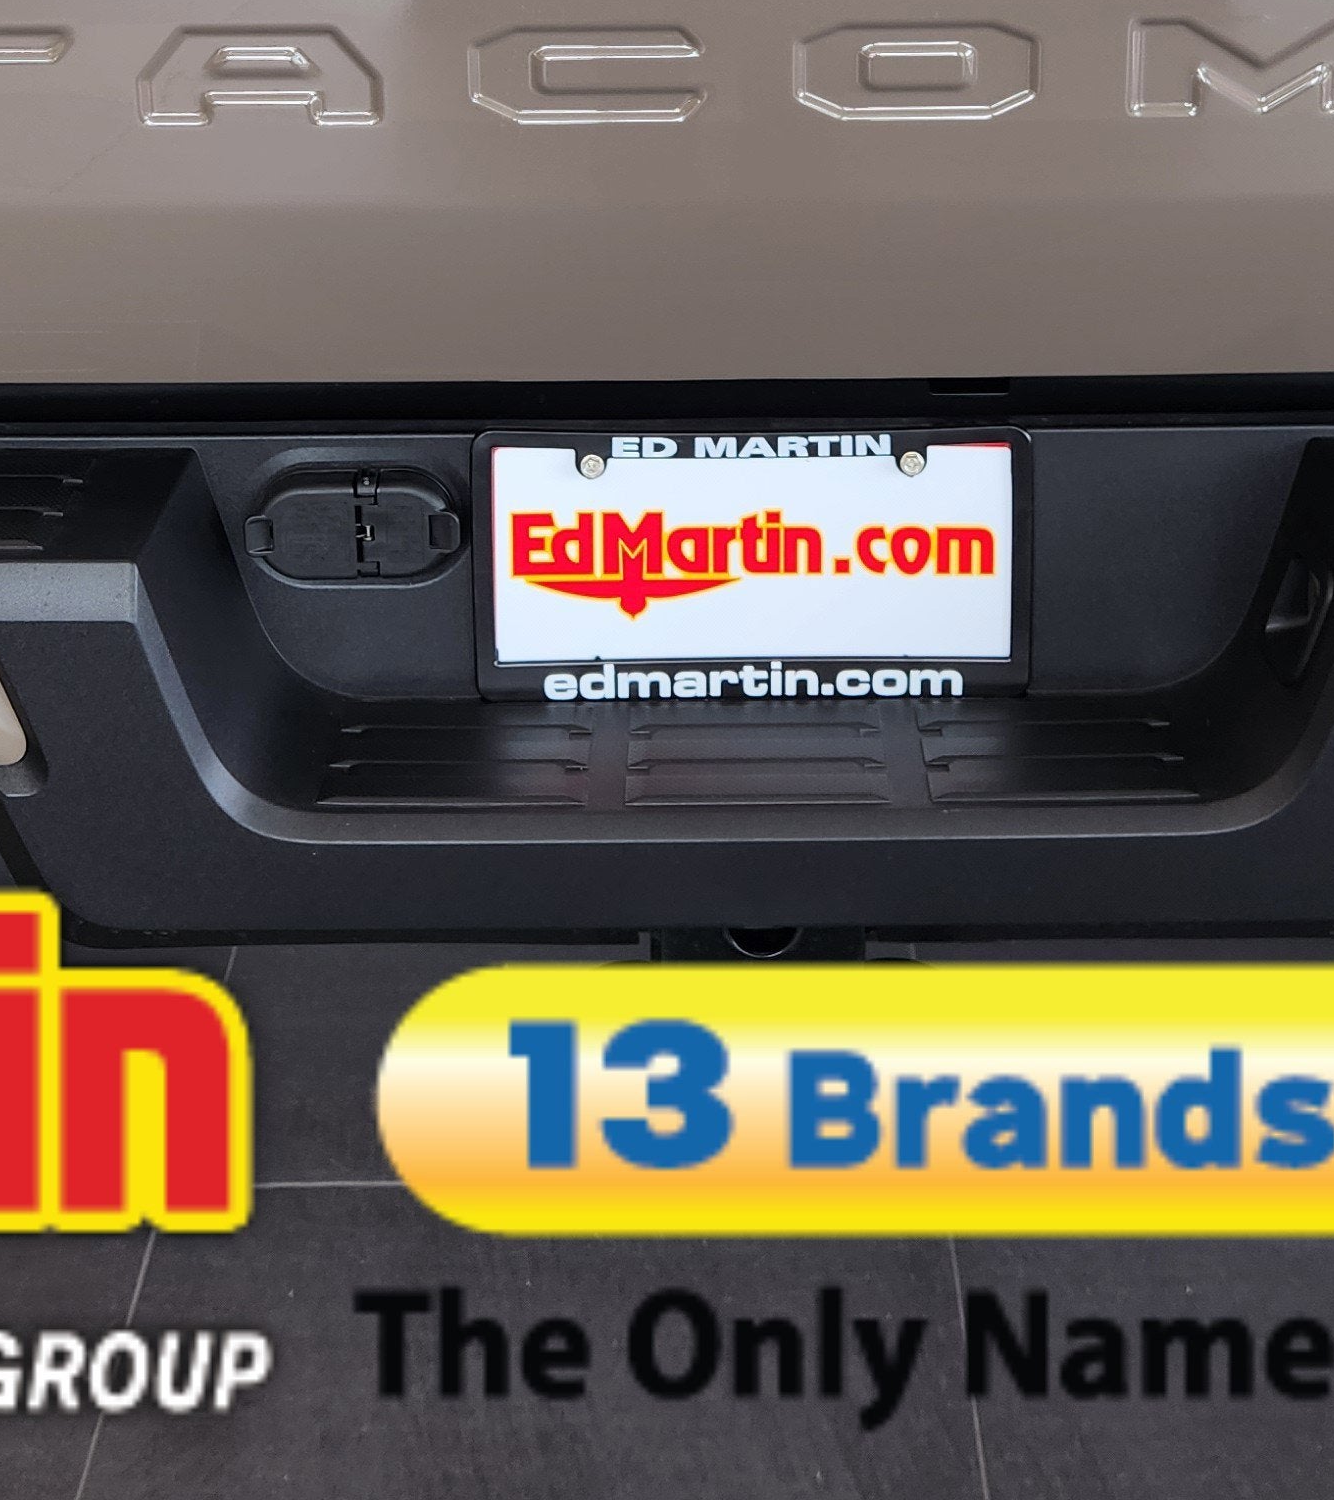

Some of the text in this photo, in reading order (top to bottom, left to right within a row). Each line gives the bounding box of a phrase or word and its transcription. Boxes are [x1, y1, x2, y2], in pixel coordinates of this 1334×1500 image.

[610, 433, 892, 459] ED MARTIN
[543, 661, 964, 700] edmartin.com
